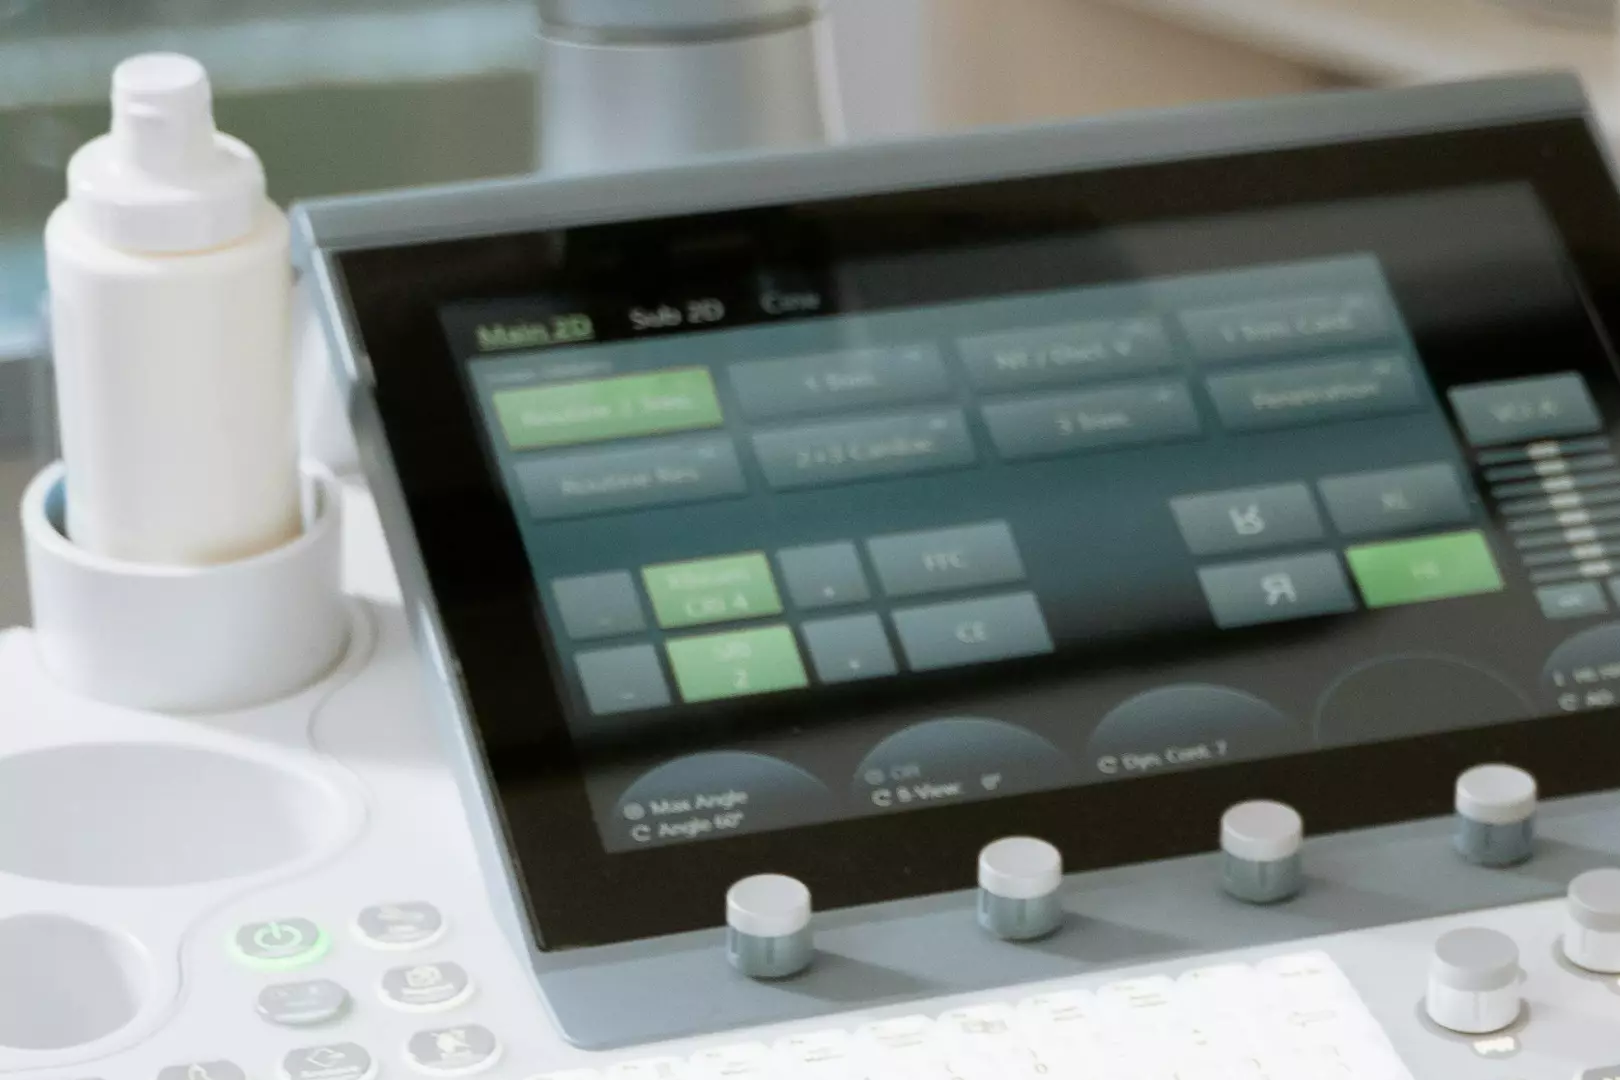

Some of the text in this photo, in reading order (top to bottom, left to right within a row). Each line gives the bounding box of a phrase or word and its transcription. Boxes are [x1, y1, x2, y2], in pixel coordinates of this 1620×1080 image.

[476, 313, 594, 350] Main 2D
[628, 297, 726, 331] Sub 2D
